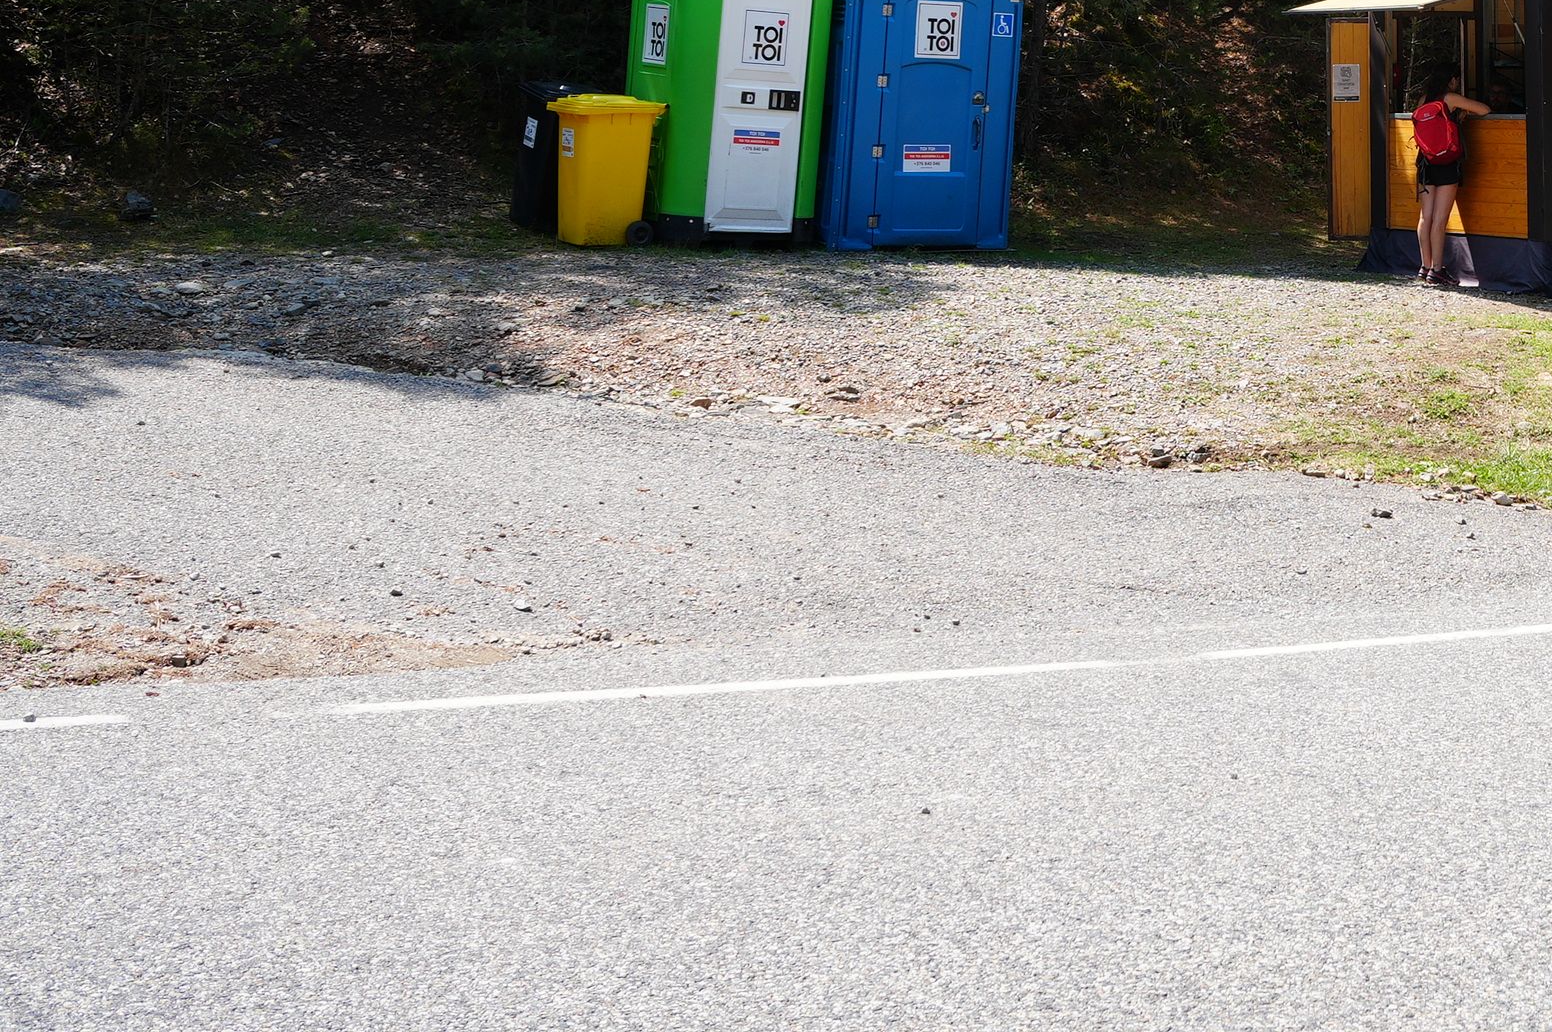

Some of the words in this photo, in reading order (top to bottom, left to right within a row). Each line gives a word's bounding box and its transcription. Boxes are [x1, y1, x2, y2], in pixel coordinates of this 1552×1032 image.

[652, 22, 666, 40] TOI
[755, 26, 783, 43] TOI
[928, 18, 955, 35] TOI
[651, 40, 665, 57] TOI
[753, 43, 782, 61] TOI
[927, 35, 954, 52] TOI
